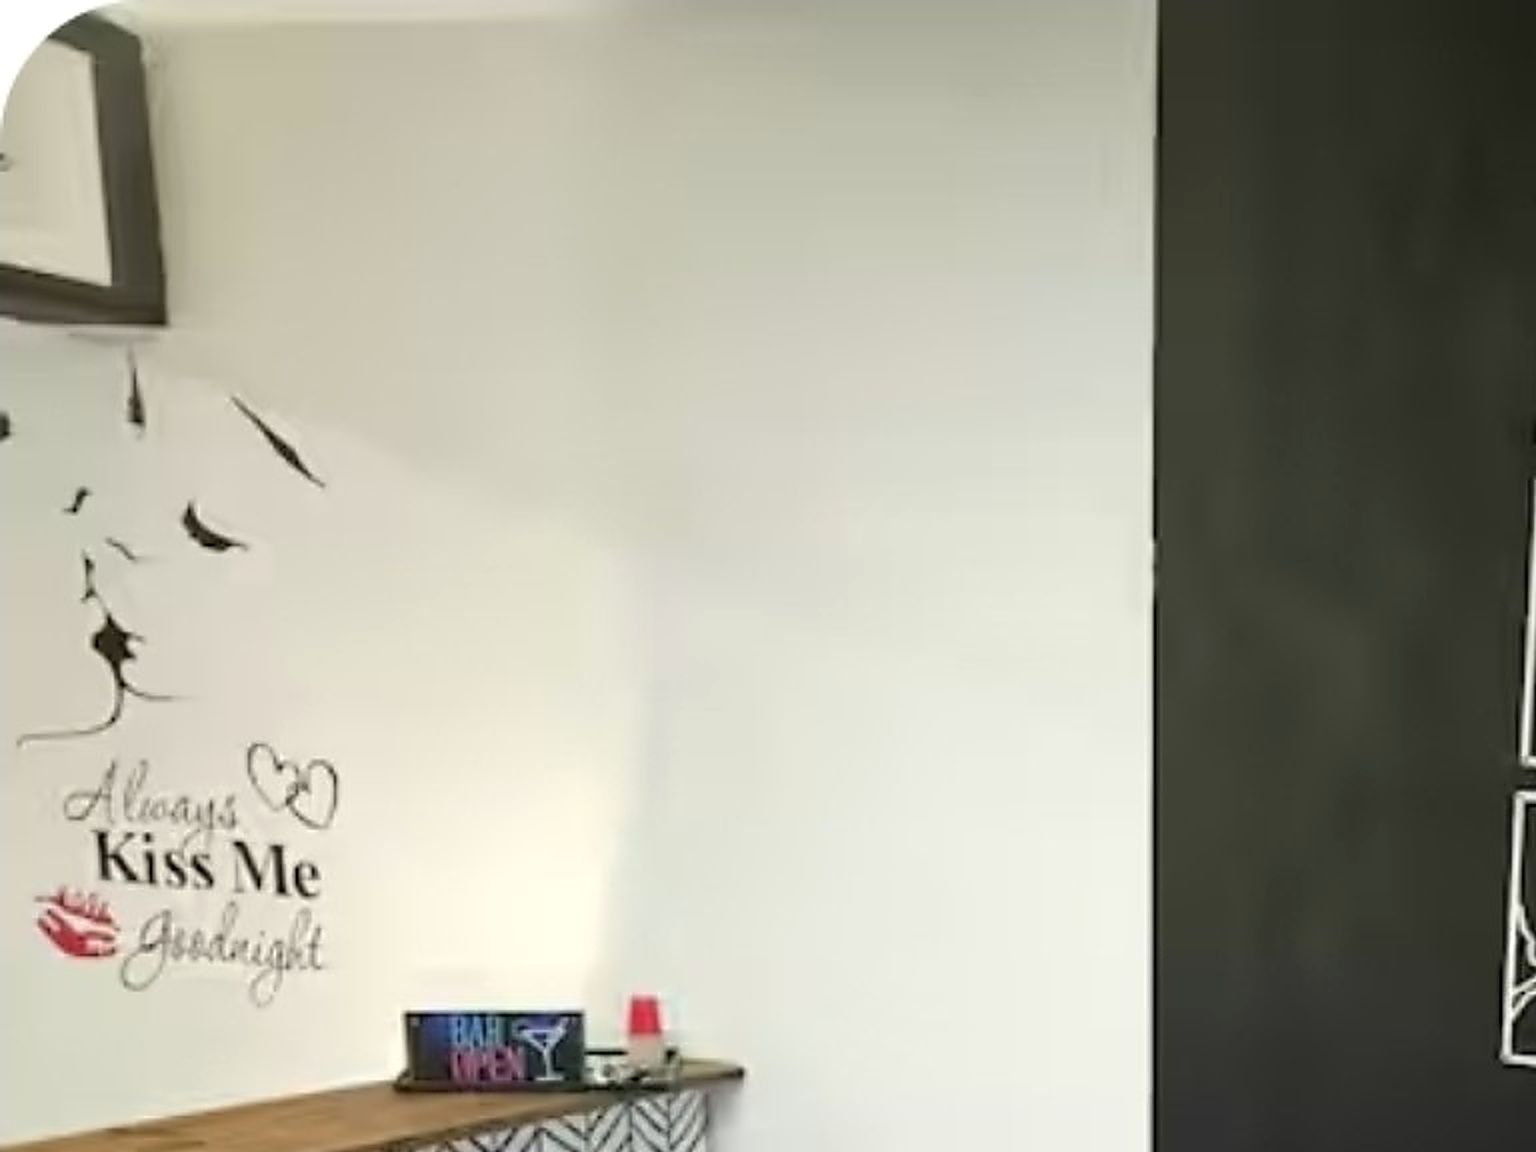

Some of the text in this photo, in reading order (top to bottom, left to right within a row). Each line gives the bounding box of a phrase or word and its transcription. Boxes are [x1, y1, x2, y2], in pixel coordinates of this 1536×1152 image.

[63, 758, 238, 854] Always
[91, 828, 322, 899] Kiss Me
